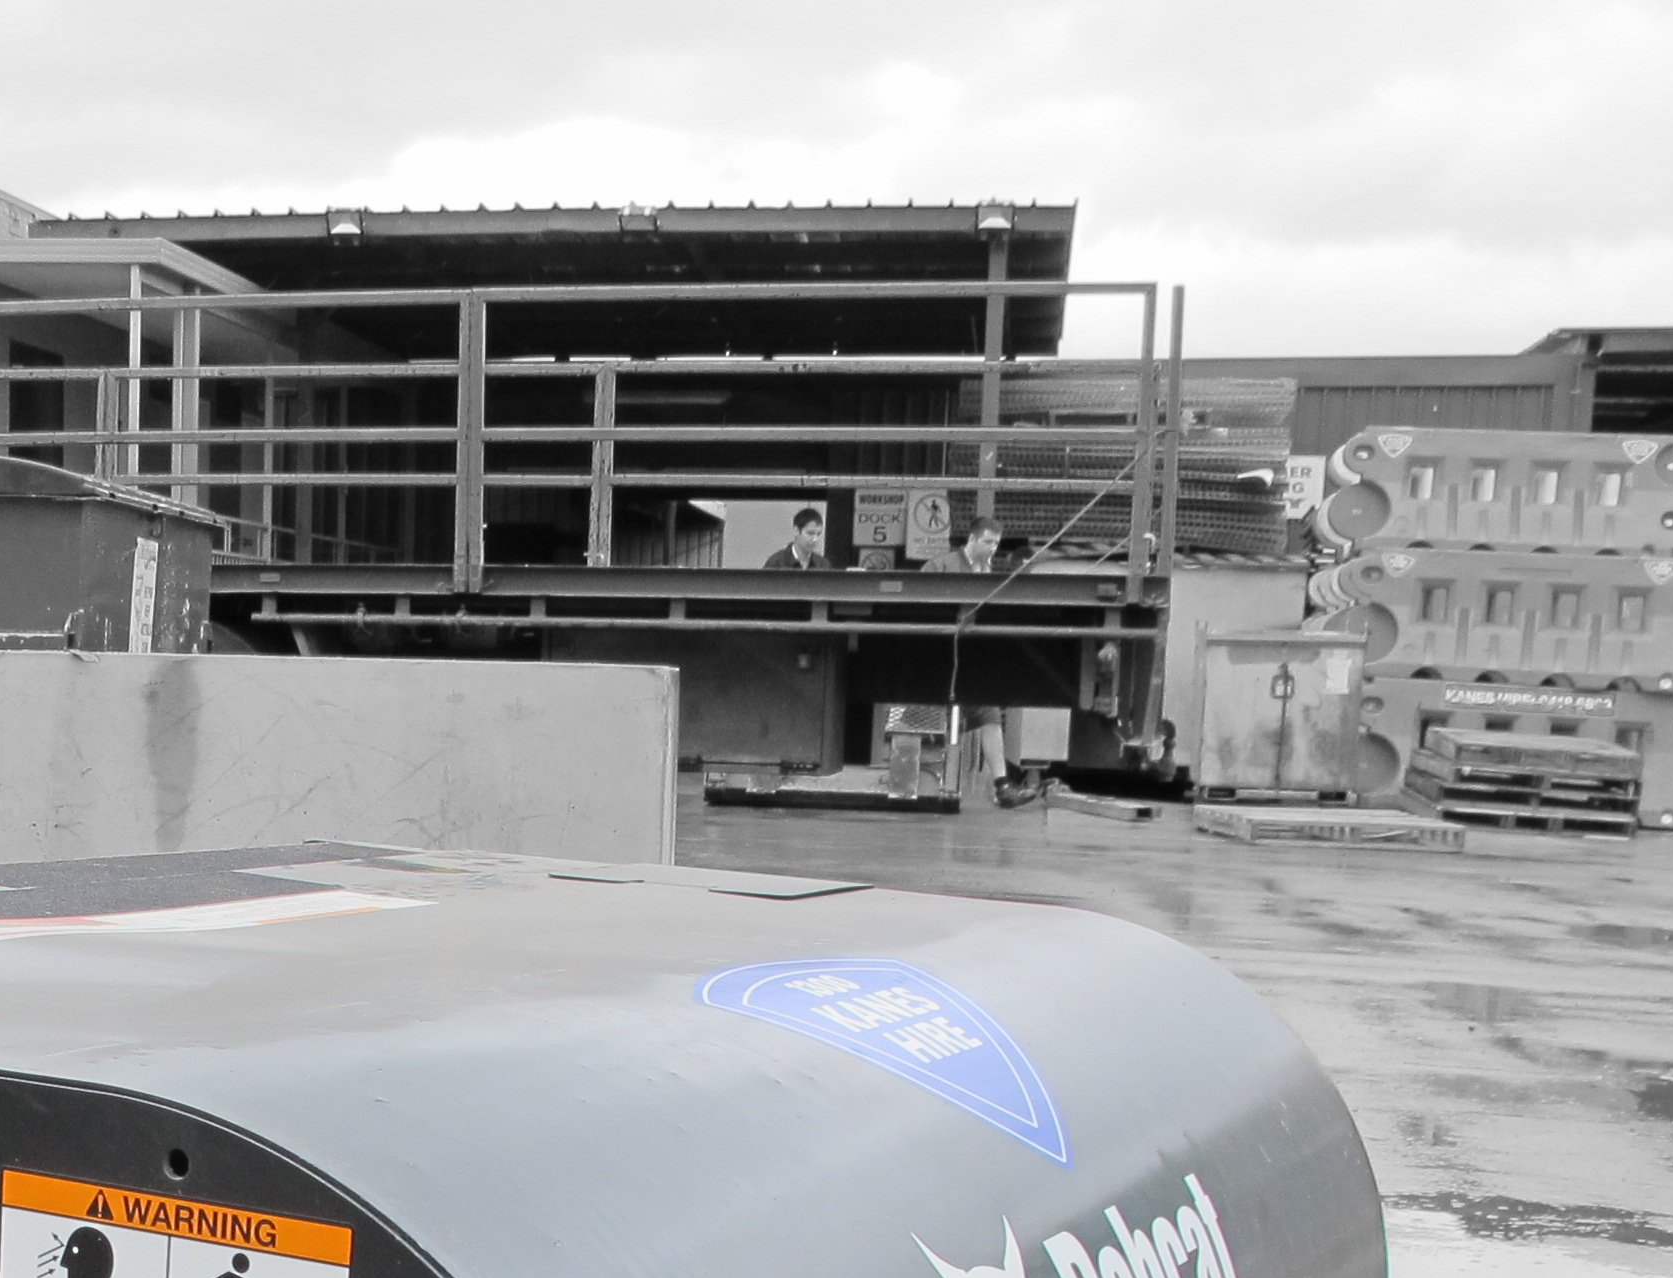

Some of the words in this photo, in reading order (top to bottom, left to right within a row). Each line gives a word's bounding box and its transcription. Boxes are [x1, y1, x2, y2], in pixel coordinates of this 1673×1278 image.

[859, 514, 900, 523] DOCK
[874, 526, 886, 542] 5
[785, 975, 862, 1000] 1300
[811, 986, 940, 1033] KANES
[884, 1017, 984, 1064] HIRE
[122, 1195, 278, 1248] WARNING
